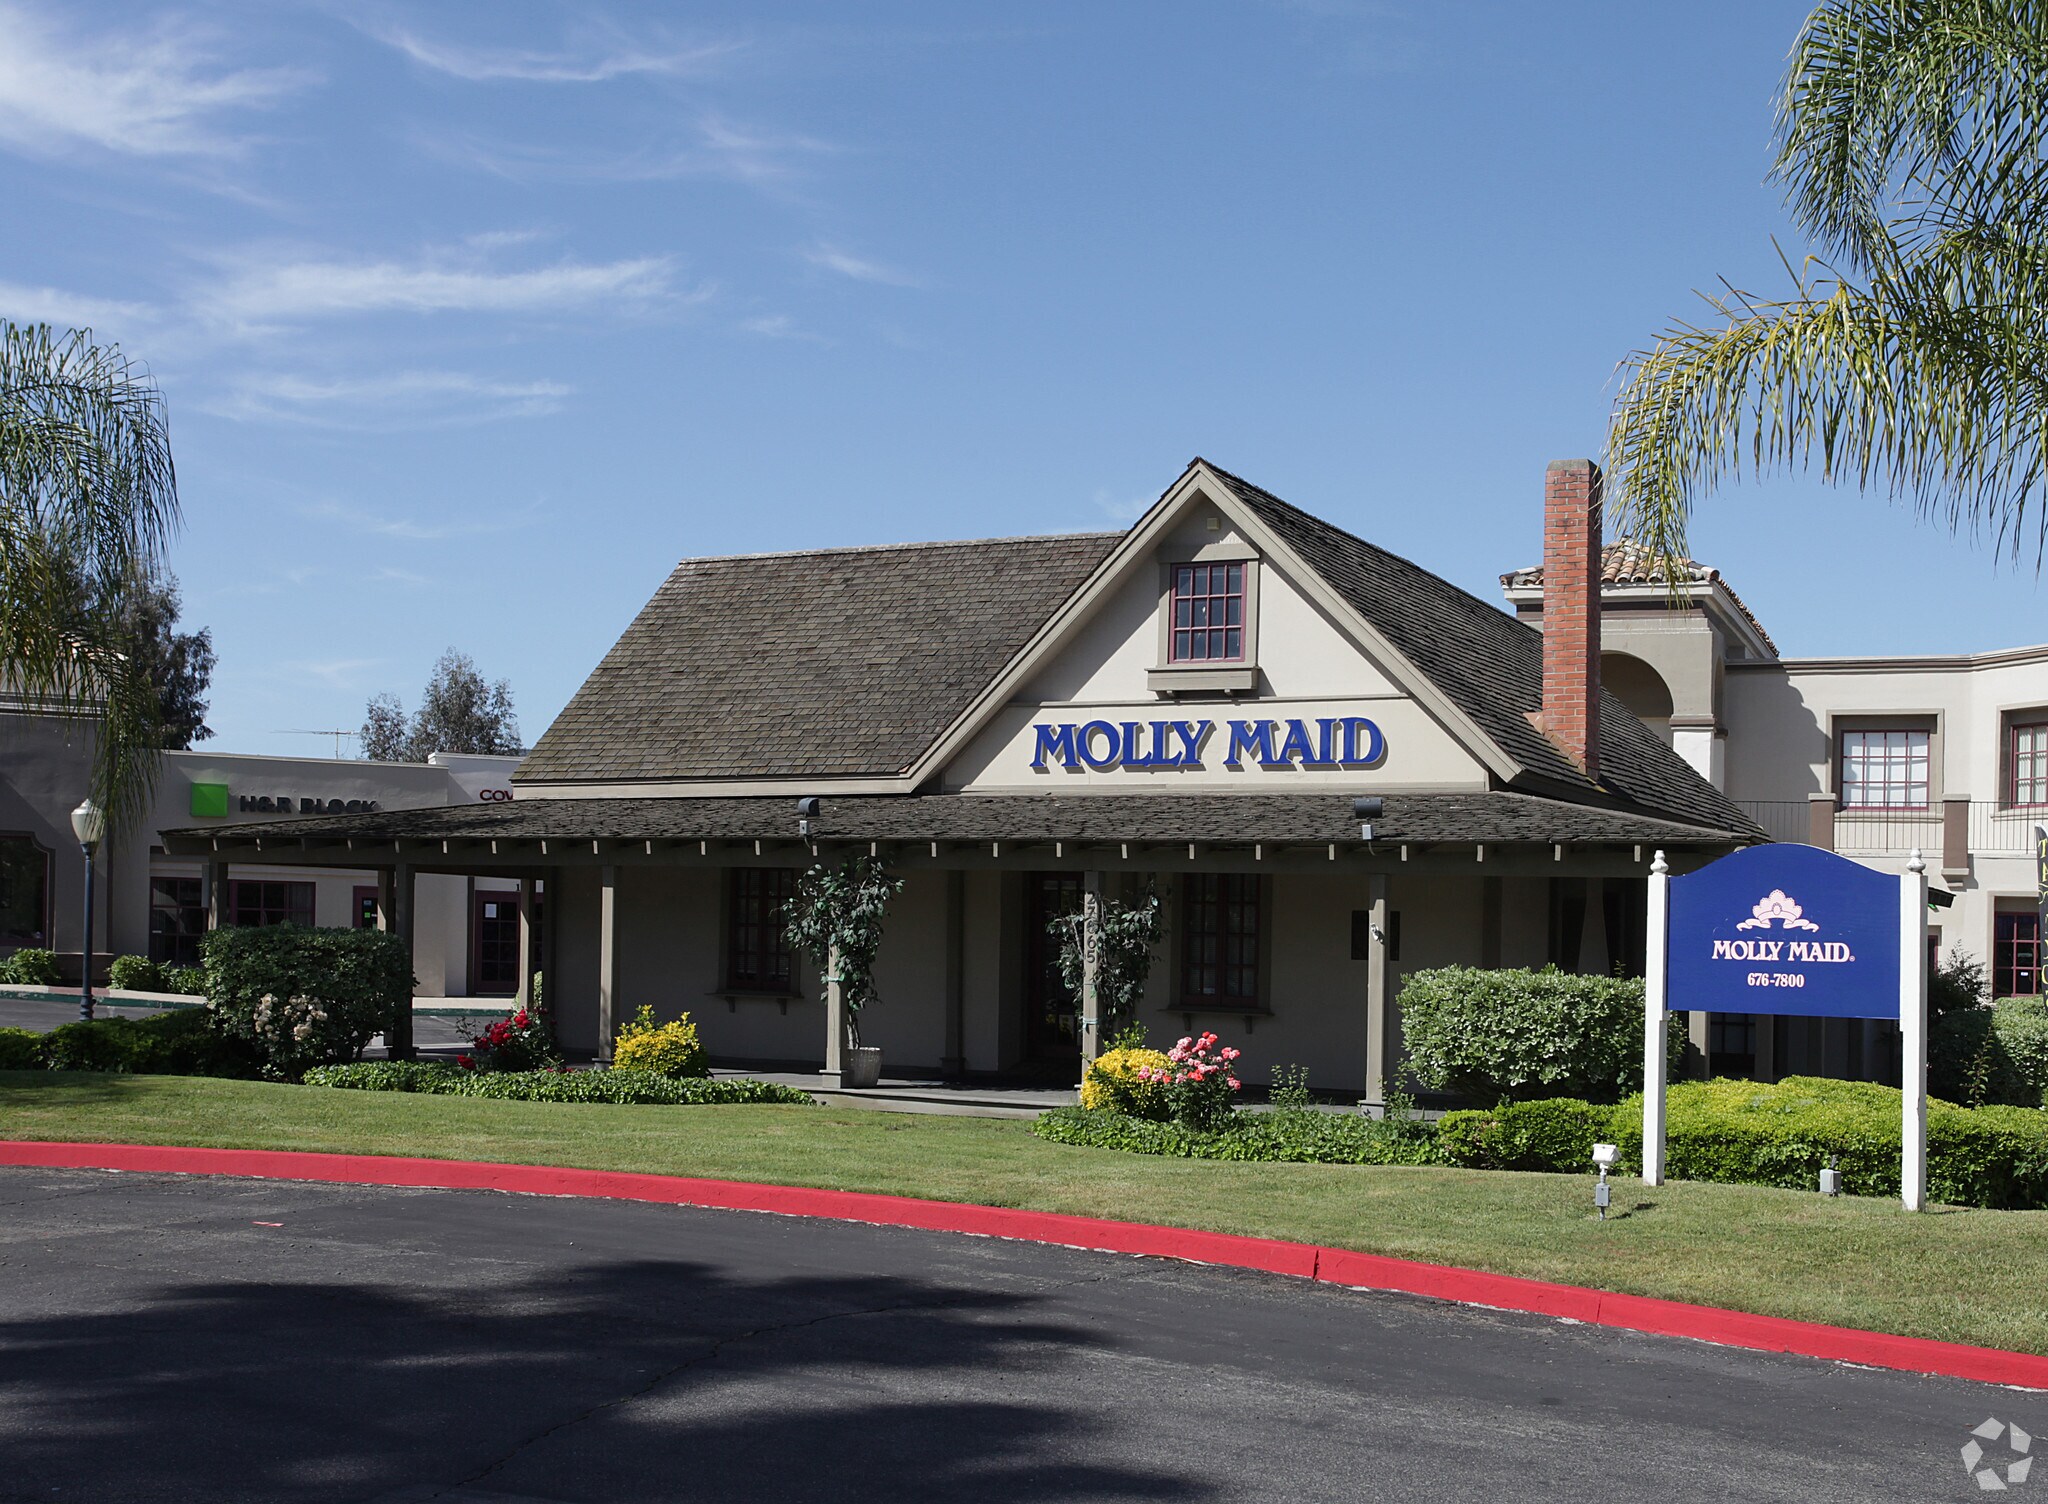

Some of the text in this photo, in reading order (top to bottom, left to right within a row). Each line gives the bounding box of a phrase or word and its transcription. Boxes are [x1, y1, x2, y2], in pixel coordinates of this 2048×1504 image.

[1030, 717, 1386, 768] MOLLY MAID
[239, 795, 377, 815] H&R BLOCK
[1711, 940, 1784, 962] MOLLY
[1747, 972, 1805, 988] 676-7800
